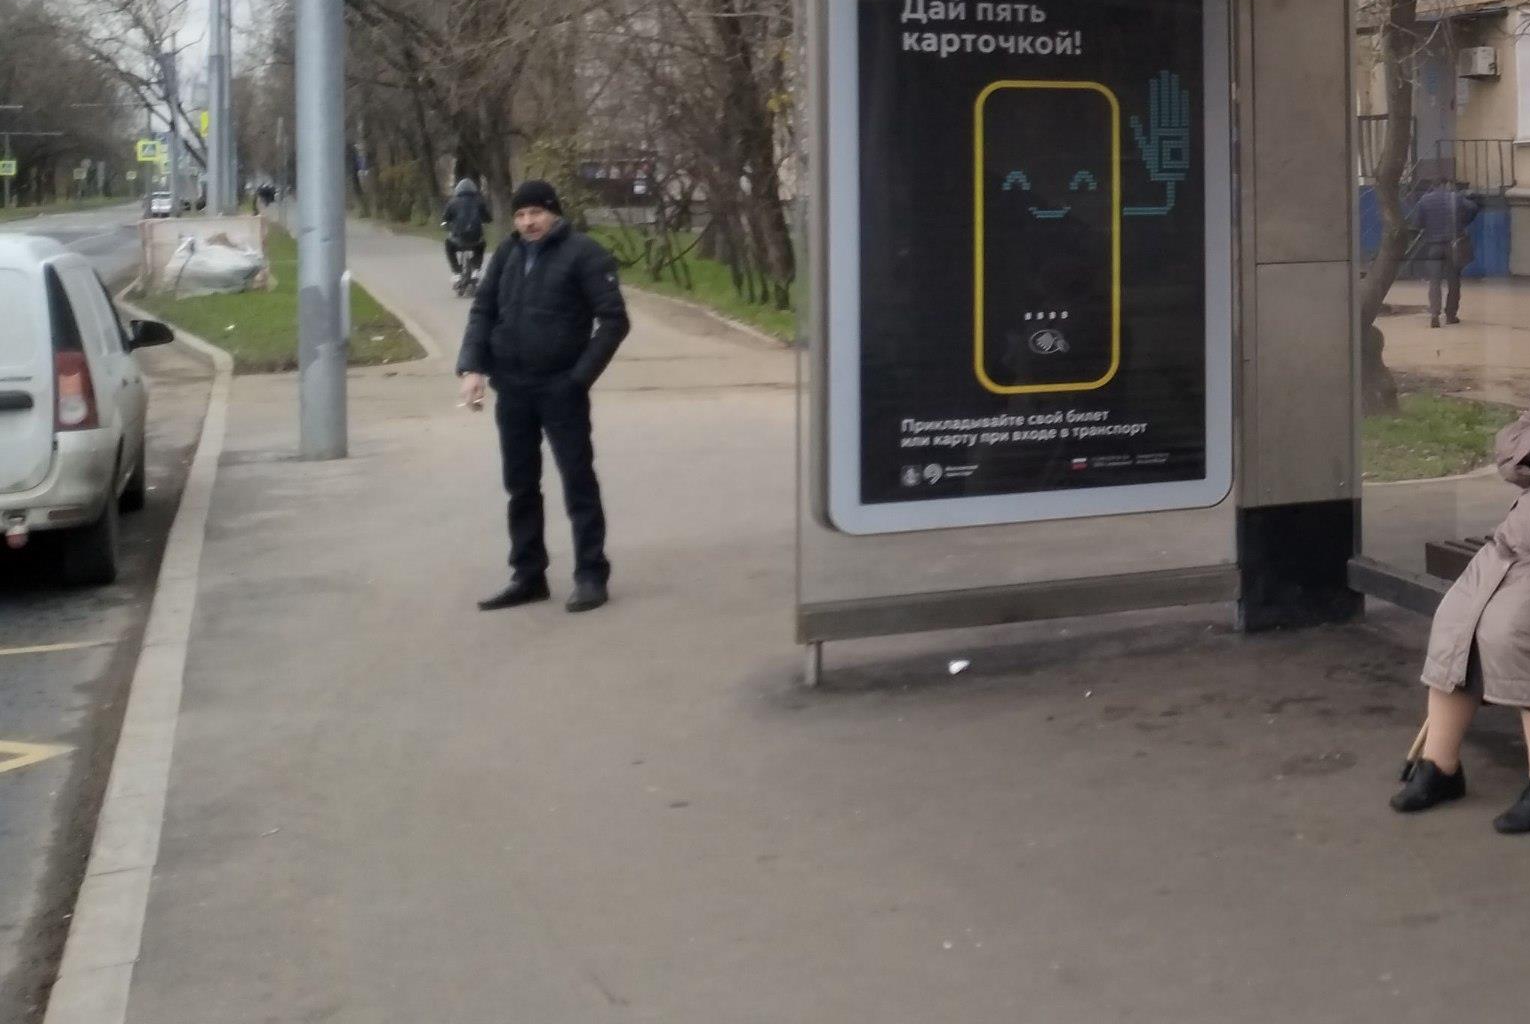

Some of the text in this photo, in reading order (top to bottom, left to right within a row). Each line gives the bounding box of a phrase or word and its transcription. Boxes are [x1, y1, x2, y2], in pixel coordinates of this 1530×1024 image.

[975, 1, 1047, 24] пять
[901, 30, 1083, 59] карточкой!
[901, 409, 1110, 433] Прикладывайте свой билет
[900, 422, 1148, 448] или карту при входе в транспорт
